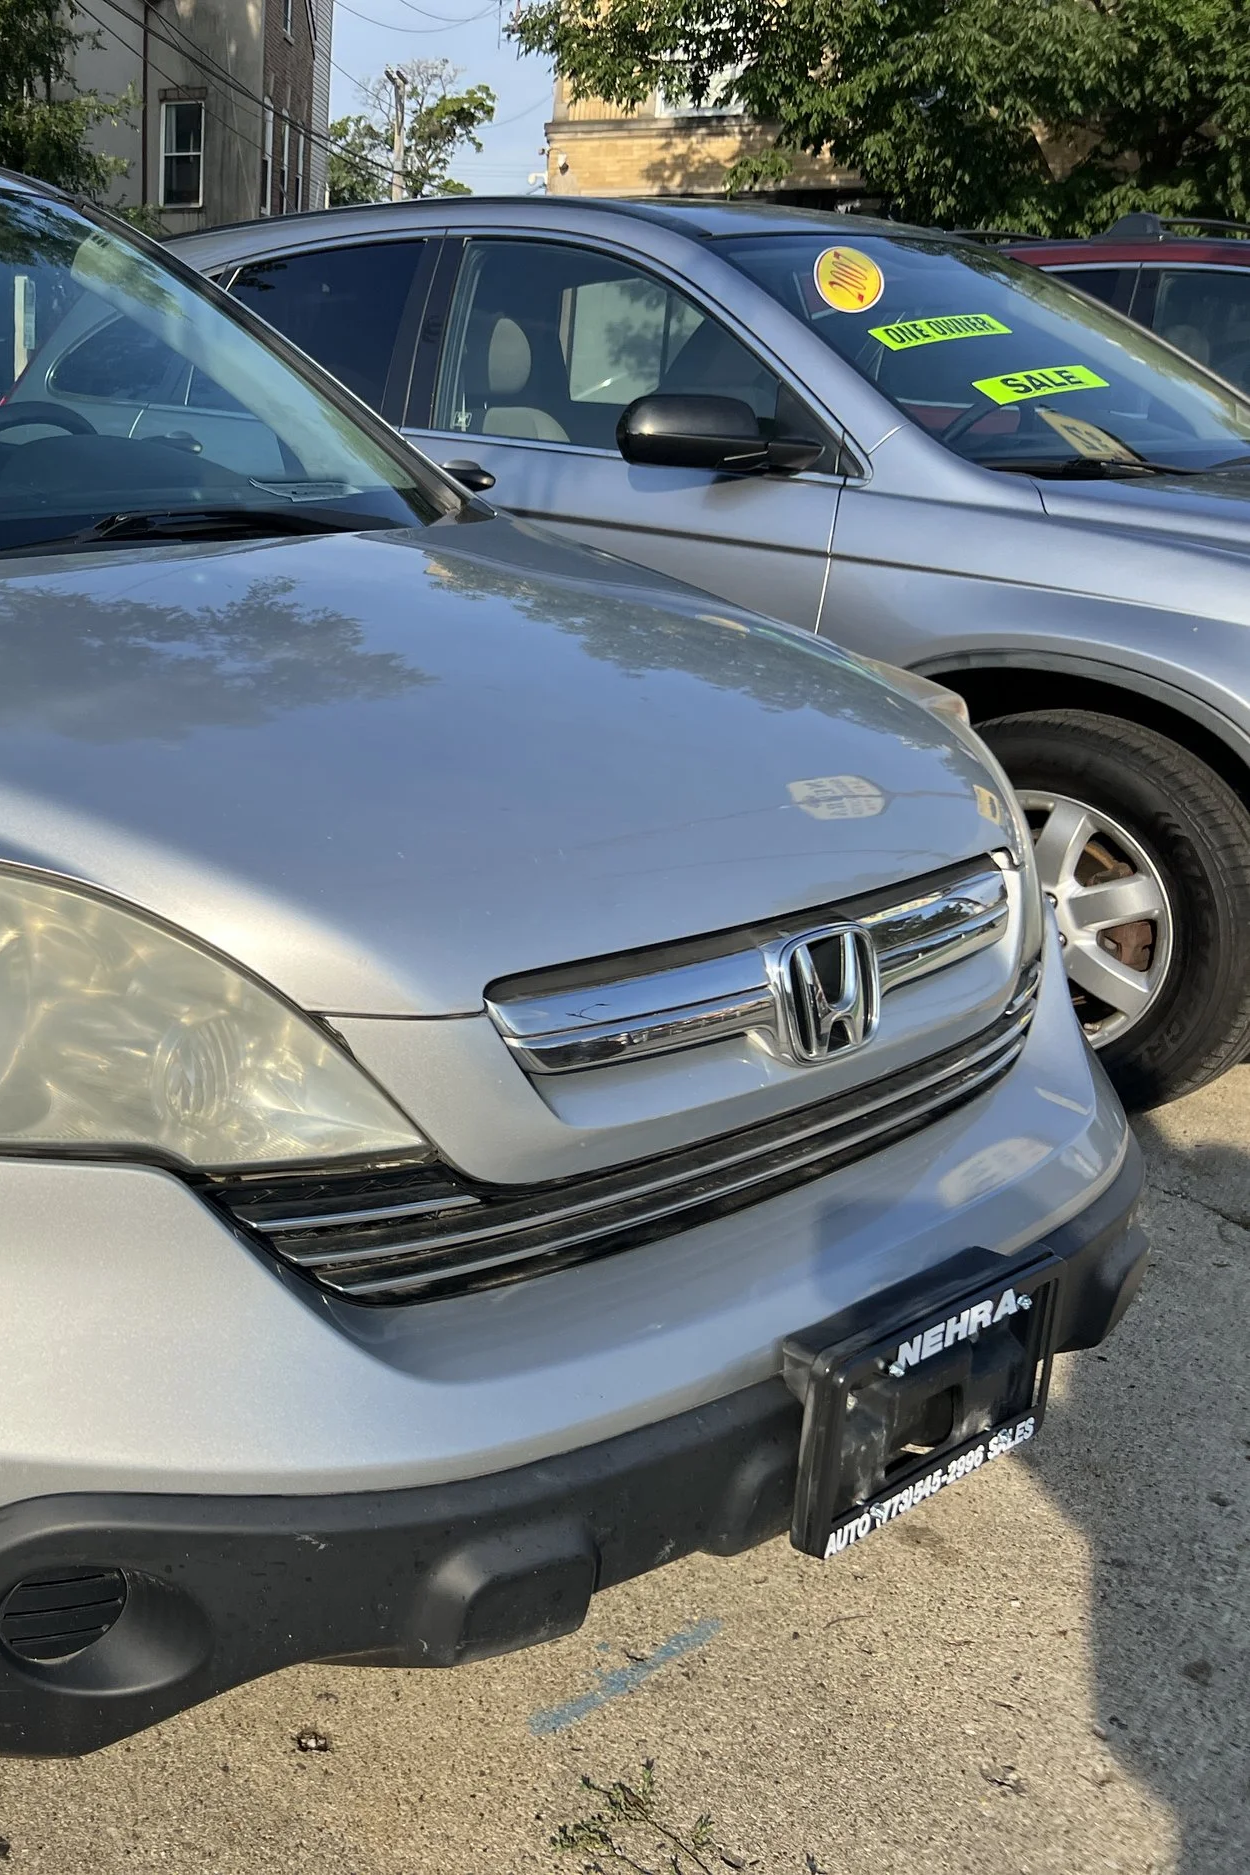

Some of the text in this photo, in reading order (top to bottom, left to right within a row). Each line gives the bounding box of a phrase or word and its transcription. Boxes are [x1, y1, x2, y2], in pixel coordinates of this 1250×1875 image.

[828, 251, 868, 304] 2007
[884, 316, 997, 344] ONE OWNER
[1000, 370, 1087, 394] SALE
[896, 1288, 1019, 1370] NEHRA
[824, 1513, 871, 1559] AUTO
